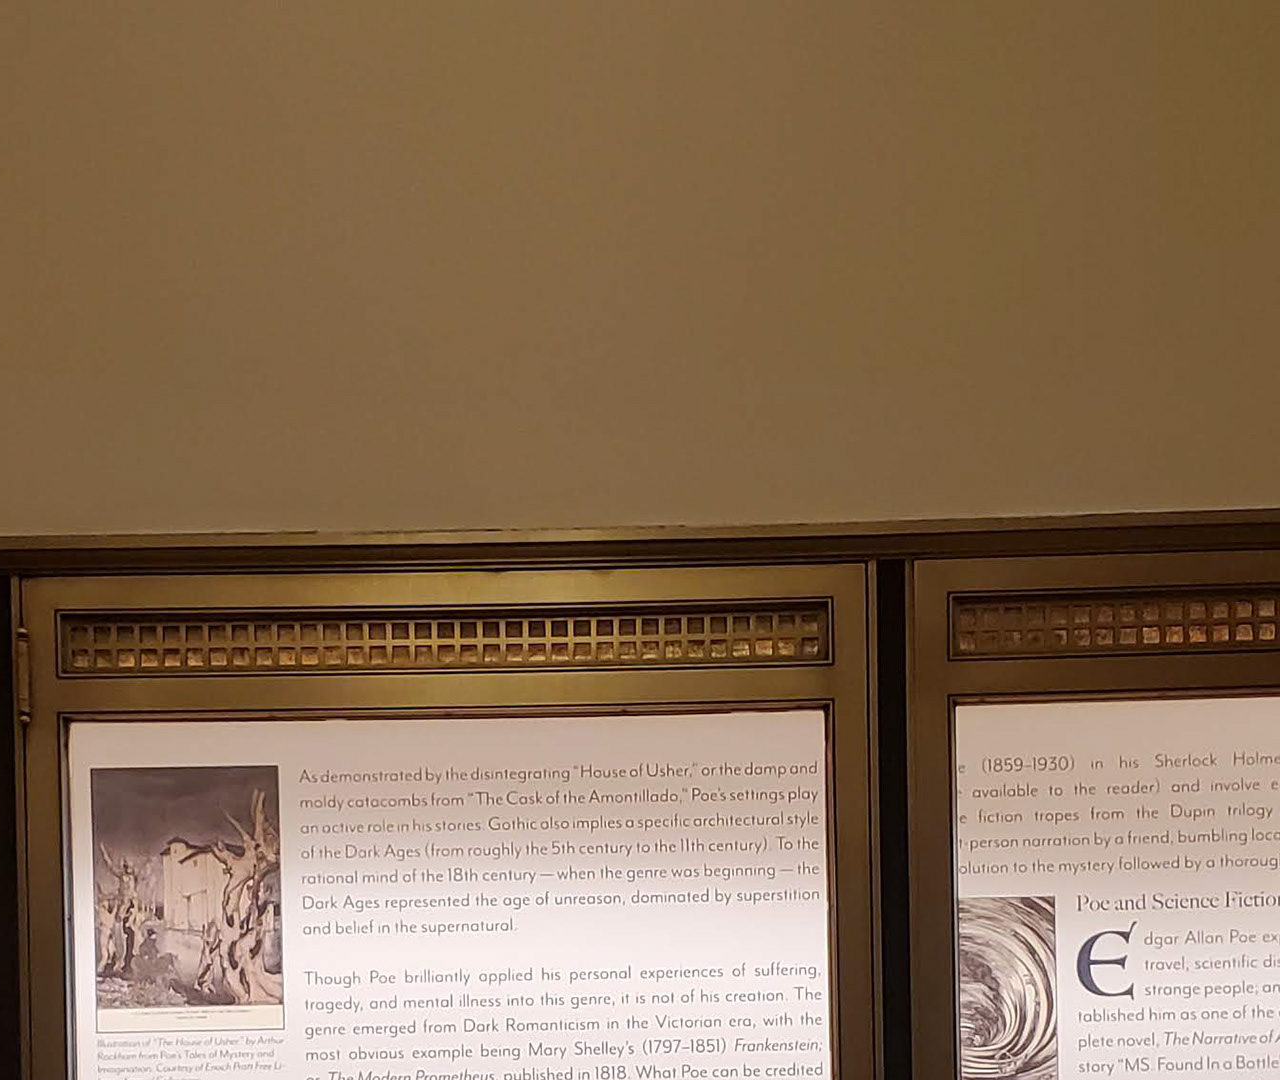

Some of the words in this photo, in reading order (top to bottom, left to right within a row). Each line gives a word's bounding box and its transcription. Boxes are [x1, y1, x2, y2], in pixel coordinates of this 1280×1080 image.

[1089, 759, 1105, 770] in
[1118, 755, 1140, 769] his
[1153, 752, 1219, 768] Sherlock
[1076, 895, 1111, 911] Poe
[1111, 894, 1148, 911] and
[1151, 893, 1221, 909] Science
[1183, 930, 1224, 944] Allan
[1228, 929, 1258, 943] Poe
[303, 970, 362, 988] Though
[369, 970, 397, 984] Poe
[403, 969, 472, 986] brilliantly
[477, 968, 534, 985] applied
[540, 967, 562, 980] his
[569, 966, 632, 984] personal
[639, 967, 724, 982] experiences
[731, 963, 747, 977] of
[304, 1026, 347, 1040] genre
[352, 1020, 417, 1038] emerged
[422, 1019, 458, 1033] from
[462, 1018, 500, 1032] Dark
[505, 1017, 601, 1031] Romanticism
[606, 1018, 620, 1029] in
[625, 1016, 650, 1029] the
[654, 1015, 723, 1028] Victorian
[762, 1013, 794, 1026] with
[799, 1012, 823, 1025] the
[220, 1050, 254, 1060] Mystery
[304, 1050, 341, 1061] most
[347, 1046, 405, 1060] obvious
[411, 1044, 474, 1062] example
[479, 1044, 522, 1061] being
[527, 1042, 568, 1060] Mary
[573, 1041, 635, 1060] Shelley's
